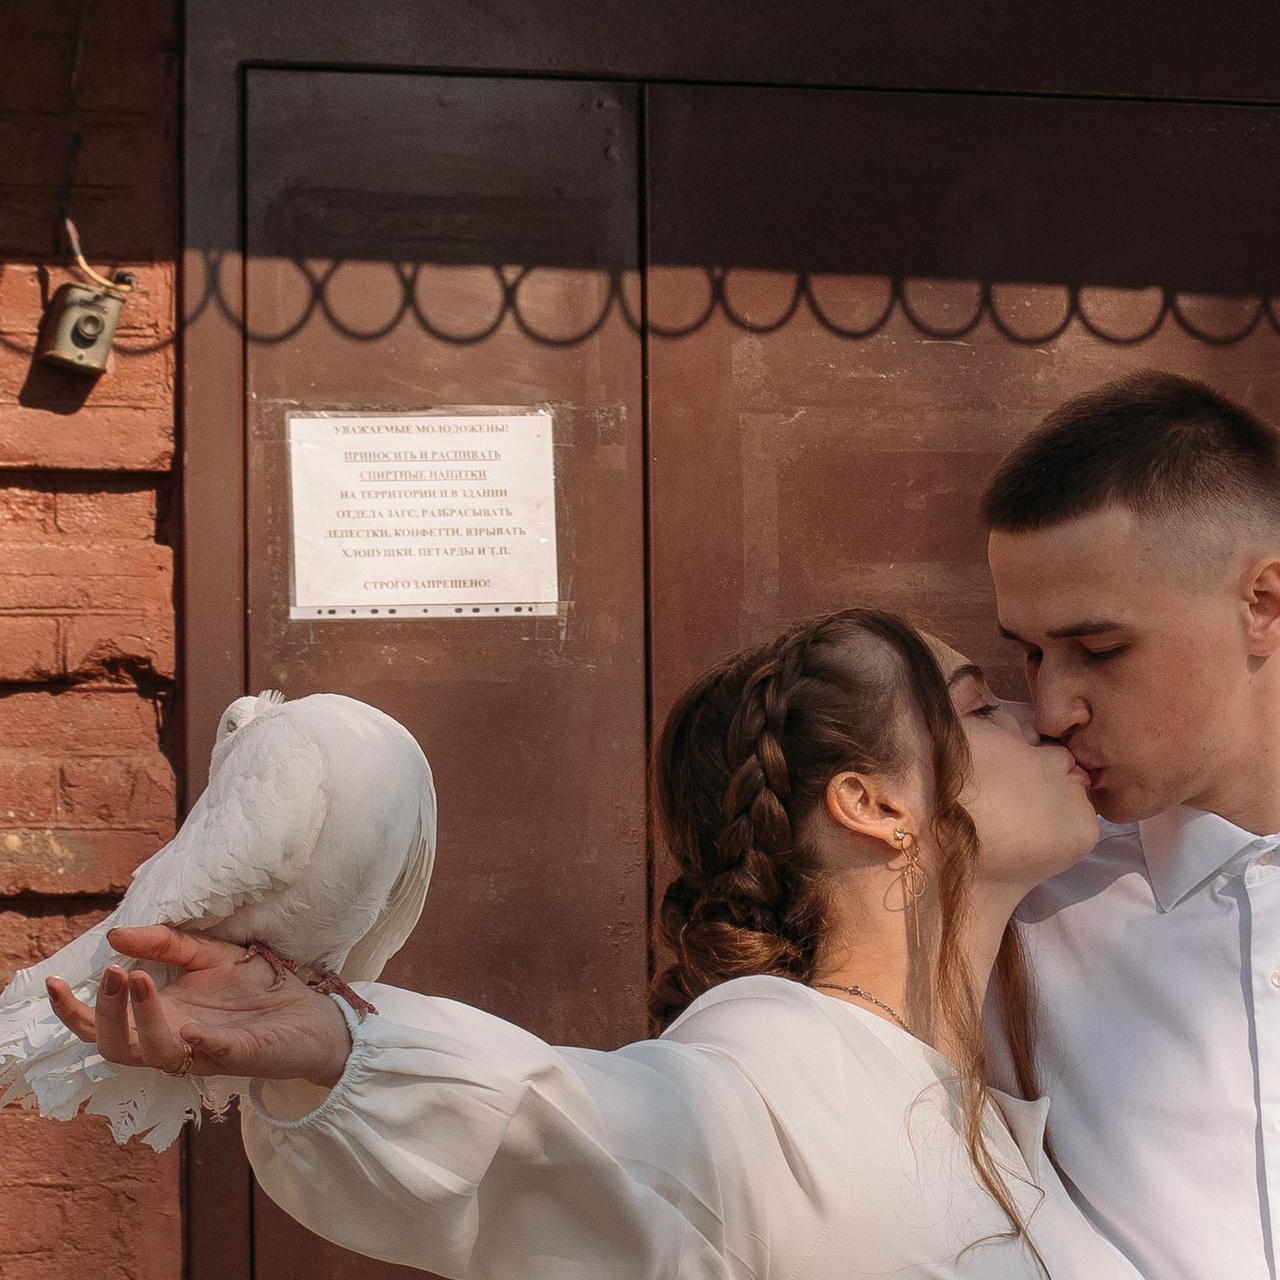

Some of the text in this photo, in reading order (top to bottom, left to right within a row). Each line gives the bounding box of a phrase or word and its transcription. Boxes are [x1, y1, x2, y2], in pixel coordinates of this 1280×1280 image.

[334, 424, 509, 434] УВАЖАЕМЫЕ МОЛОДОЖЕНЫ!
[344, 450, 501, 461] ПРИНОСИТЬ И РАСПИВАТЬ
[360, 469, 487, 480] СПИРТНЫЕ НАПИТКИ
[340, 488, 508, 499] НА ТЕРРИТОРИИ И В ЗДАНИИ
[336, 510, 383, 519] ОТДЕЛА
[422, 508, 513, 518] РАЗБРАСЫВАТЬ
[466, 527, 526, 536] ВЗРЫВАТЬ
[418, 547, 475, 557] ПЕТАРДЫ
[478, 547, 486, 556] И
[363, 579, 490, 590] СТРОГО ЗАПРЕЩЕНО!
